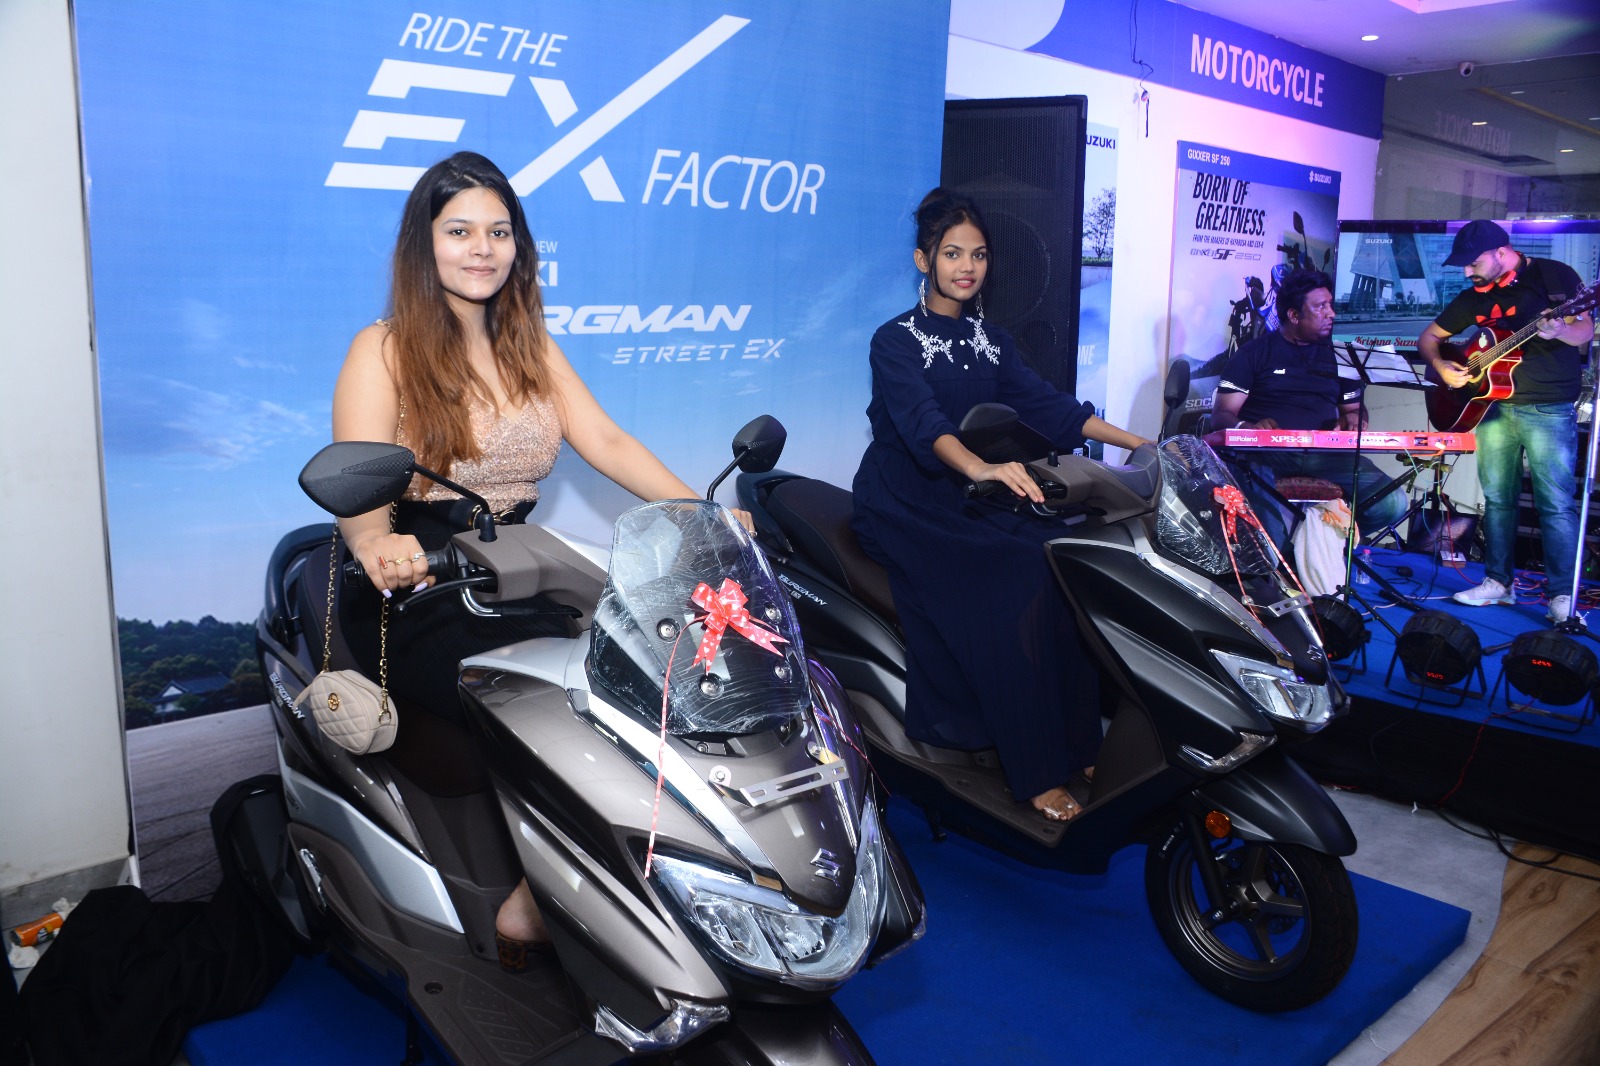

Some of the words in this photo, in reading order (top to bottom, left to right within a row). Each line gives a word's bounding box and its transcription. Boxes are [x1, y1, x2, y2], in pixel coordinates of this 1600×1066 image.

[399, 13, 494, 57] RIDE
[497, 26, 568, 67] THE
[1191, 34, 1325, 108] MOTORCYCLE
[324, 14, 752, 203] EX
[1086, 134, 1115, 149] UZUKI
[1188, 149, 1210, 163] GIXXER
[1212, 154, 1219, 164] SF
[1220, 155, 1230, 166] 250
[641, 148, 826, 215] FACTOR
[1193, 171, 1231, 203] BORN
[1232, 179, 1250, 205] OF
[1195, 202, 1266, 236] GREATNESS.
[1235, 252, 1261, 261] 250
[543, 304, 752, 335] RGMAN
[612, 344, 735, 364] STREET
[742, 338, 786, 359] EX
[1394, 336, 1418, 347] Suzu
[778, 574, 827, 605] BURGMAN
